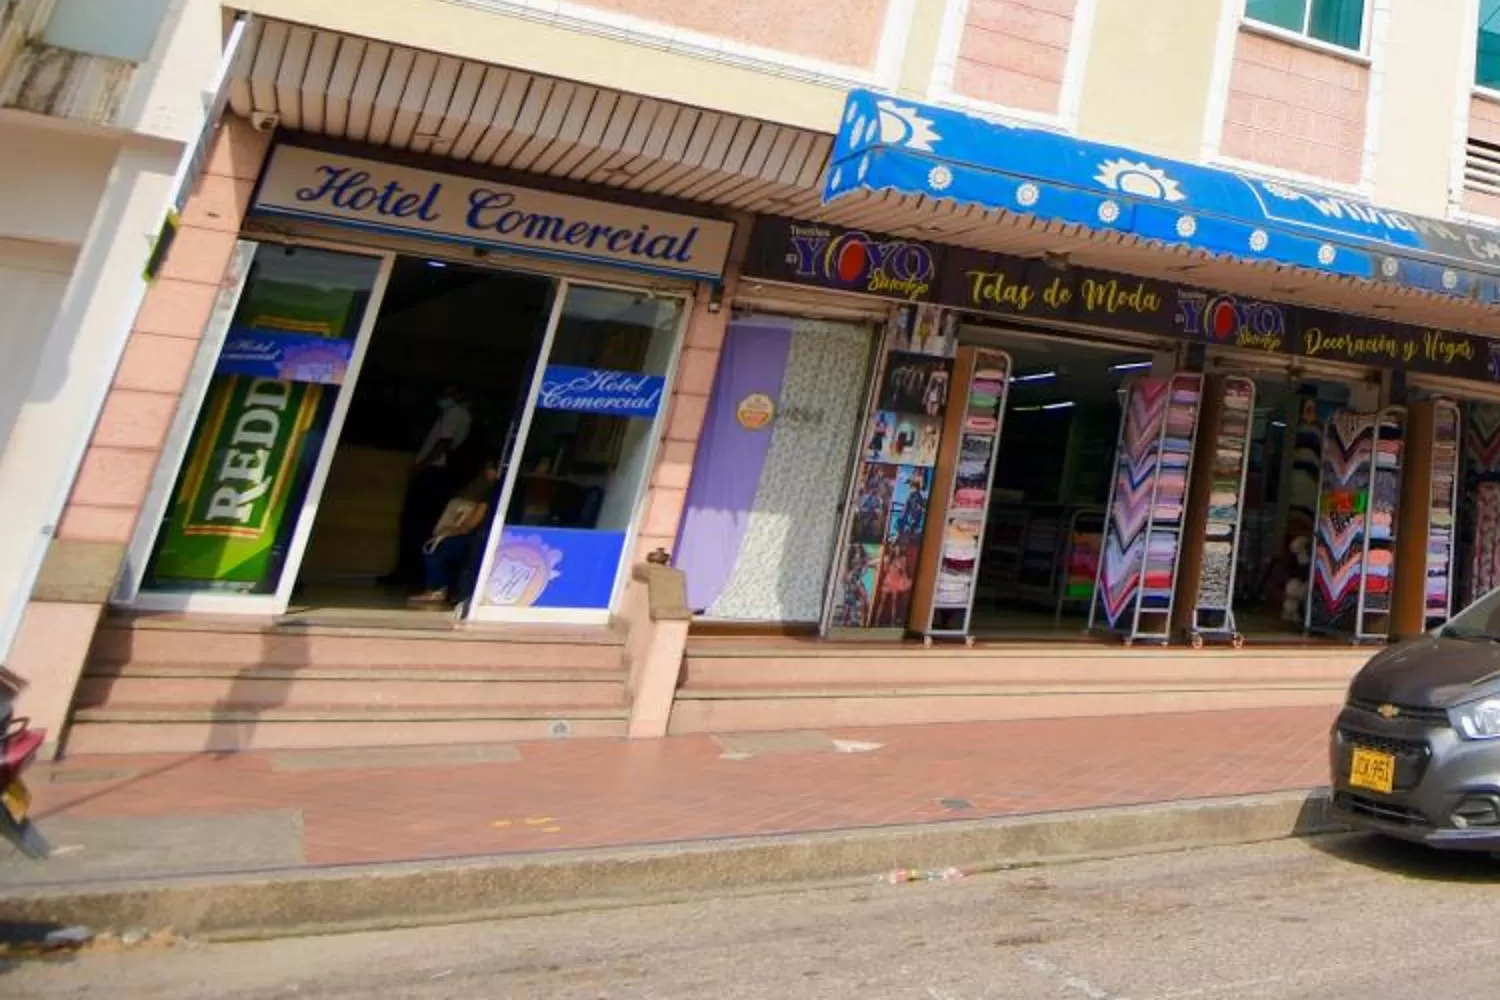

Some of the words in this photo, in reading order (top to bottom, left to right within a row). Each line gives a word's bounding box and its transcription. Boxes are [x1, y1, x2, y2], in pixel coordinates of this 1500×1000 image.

[296, 164, 441, 222] Hotel
[465, 187, 700, 264] Comercial
[789, 230, 936, 288] YOYO
[960, 268, 1034, 311] Telas
[1043, 276, 1073, 310] de
[1082, 278, 1164, 314] Moda
[1403, 339, 1419, 361] y
[1423, 329, 1475, 364] Hogar
[541, 380, 661, 410] Comercial
[571, 370, 651, 393] Hotel
